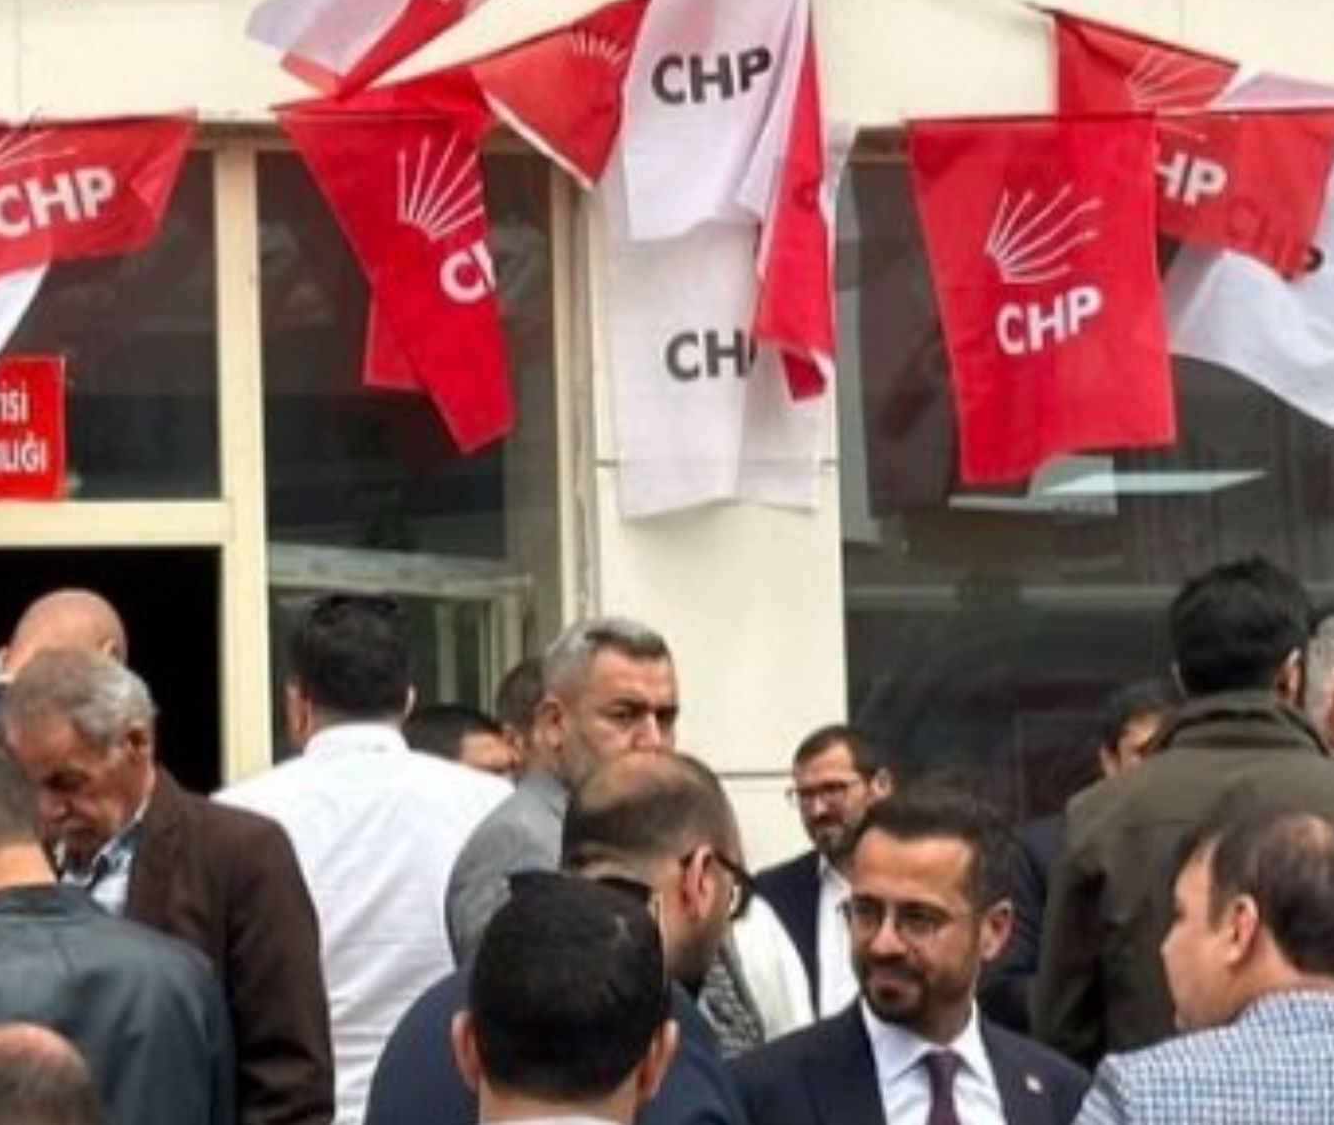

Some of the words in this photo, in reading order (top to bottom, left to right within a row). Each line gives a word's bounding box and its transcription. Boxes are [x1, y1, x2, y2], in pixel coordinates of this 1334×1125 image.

[651, 47, 772, 104] CHP
[1153, 150, 1229, 205] HP
[996, 286, 1103, 355] CHP
[664, 329, 759, 382] CH
